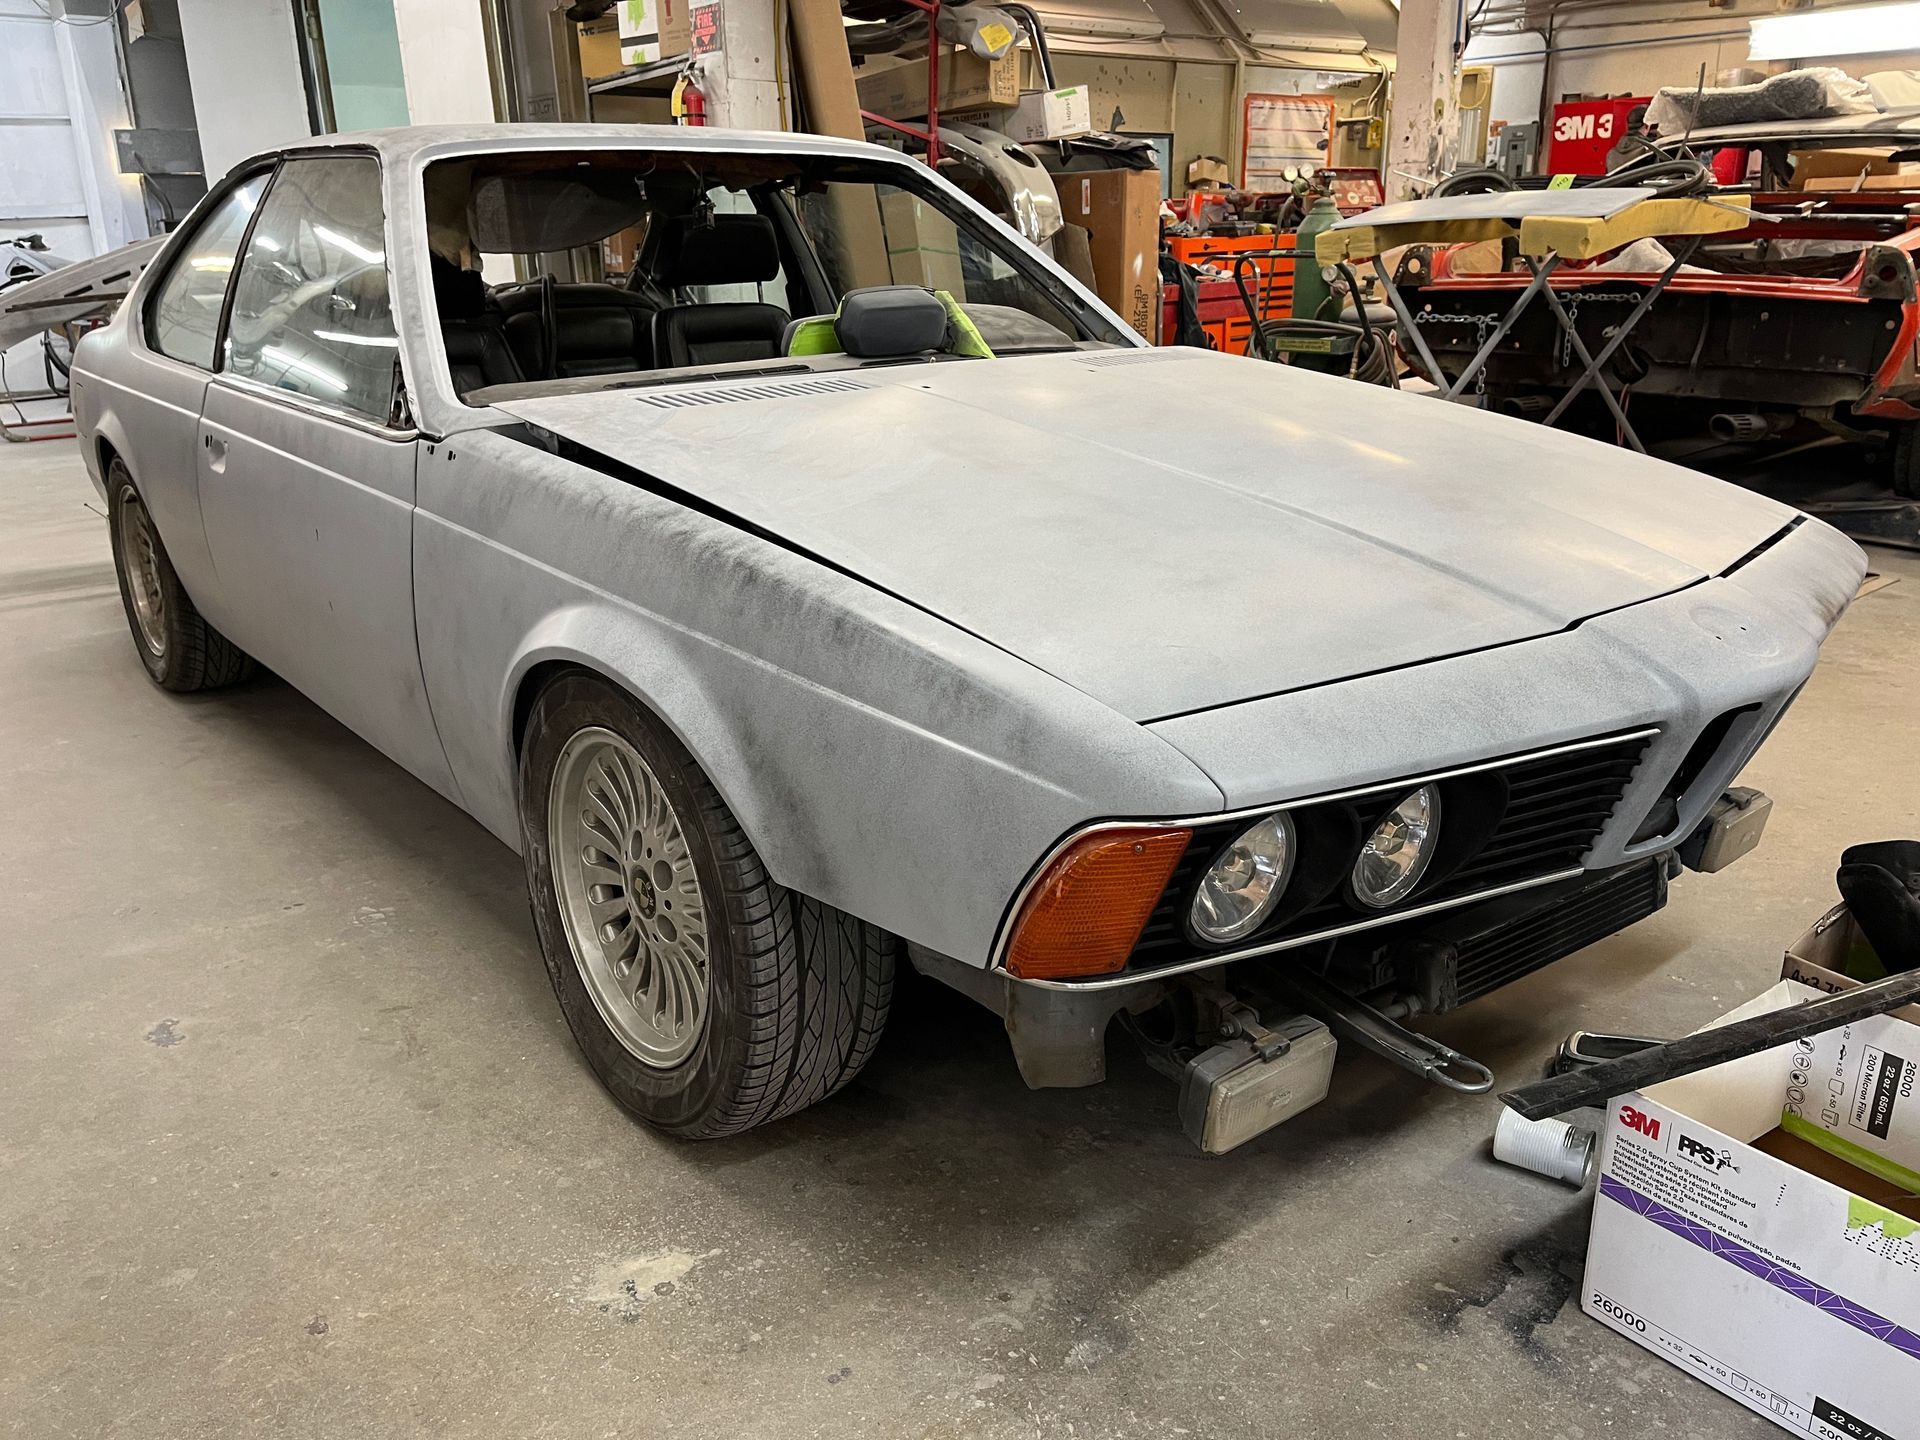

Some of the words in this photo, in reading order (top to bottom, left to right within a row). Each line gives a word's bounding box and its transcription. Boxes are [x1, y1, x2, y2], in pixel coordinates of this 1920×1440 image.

[696, 12, 713, 29] FIRE
[1554, 114, 1595, 141] 3M
[1843, 1030, 1851, 1040] 32
[1836, 1067, 1843, 1077] 50
[1866, 1053, 1877, 1072] 200
[1885, 1065, 1896, 1079] 22
[1860, 1072, 1873, 1100] Micron
[1883, 1079, 1890, 1089] oz
[1900, 1060, 1917, 1098] 26000
[1829, 1099, 1837, 1109] 50
[1856, 1101, 1867, 1122] Filter
[1877, 1097, 1889, 1113] 650
[1619, 1105, 1661, 1141] 3M
[1874, 1113, 1884, 1125] mL
[1677, 1134, 1715, 1165] PPS
[1613, 1155, 1637, 1173] Sistema
[1638, 1170, 1647, 1179] de
[1648, 1175, 1668, 1188] Juego
[1670, 1186, 1678, 1195] de
[1680, 1190, 1698, 1203] Tazas
[1615, 1142, 1639, 1158] Trousse
[1641, 1155, 1649, 1164] de
[1679, 1174, 1687, 1183] de
[1689, 1181, 1719, 1199] récipient
[1720, 1196, 1736, 1206] pour
[1616, 1135, 1635, 1148] Series
[1636, 1145, 1647, 1155] 2.0
[1649, 1151, 1667, 1165] Spray
[1669, 1162, 1683, 1172] Cup
[1684, 1169, 1709, 1185] System
[1724, 1189, 1756, 1208] Standard
[1655, 1185, 1671, 1197] Serie
[1673, 1194, 1684, 1203] 2.0
[1665, 1176, 1682, 1189] série
[1697, 1191, 1728, 1210] standard
[1611, 1169, 1629, 1183] Series
[1631, 1180, 1641, 1189] 2.0
[1643, 1186, 1651, 1195] Kit
[1663, 1198, 1688, 1213] sistema
[1699, 1216, 1716, 1227] copo
[1718, 1225, 1726, 1233] de
[1775, 1254, 1801, 1271] padrão
[1592, 1293, 1646, 1333] 26000
[1673, 1343, 1683, 1353] 32
[1716, 1367, 1727, 1377] 50
[1755, 1389, 1766, 1400] 50
[1829, 1411, 1846, 1426] 22
[1847, 1423, 1862, 1435] oz
